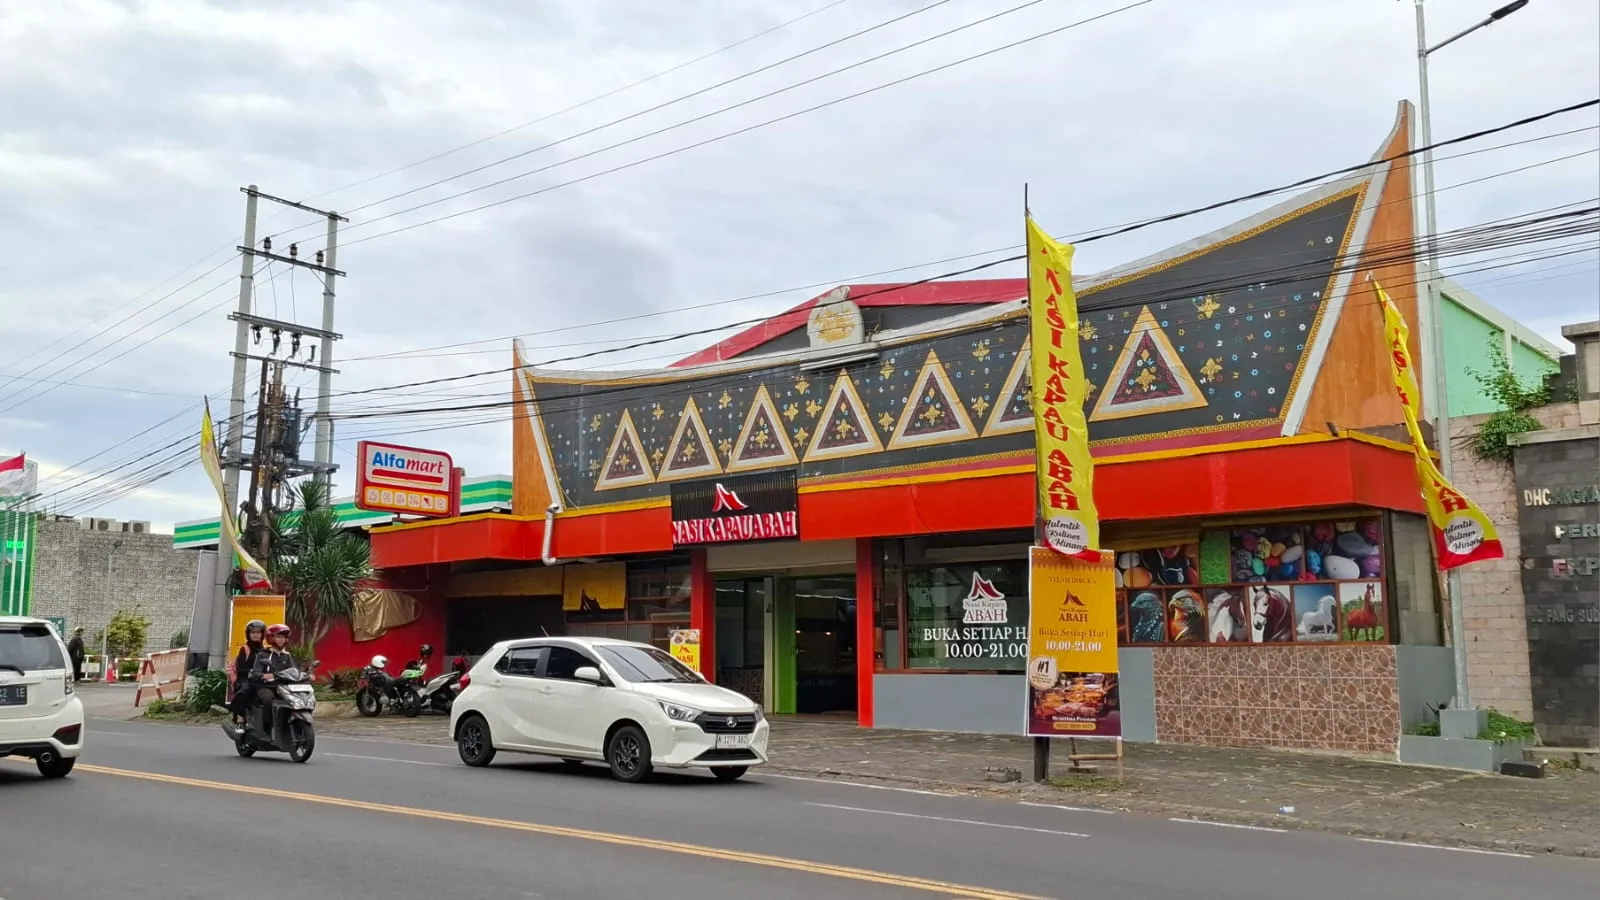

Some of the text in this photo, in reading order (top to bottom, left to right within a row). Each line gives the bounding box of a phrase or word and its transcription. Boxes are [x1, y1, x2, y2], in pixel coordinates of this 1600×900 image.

[372, 451, 444, 474] Alfamart
[1047, 448, 1080, 512] ABAH
[965, 609, 1005, 622] ABAH
[1058, 612, 1089, 623] ABAH
[924, 628, 961, 641] BUKA
[963, 627, 1012, 641] SETIAP
[1039, 627, 1109, 640] Buka Setiap Hari
[944, 643, 1028, 658] 10.00-21.00
[1045, 640, 1102, 652] 10.00-21.00
[1037, 660, 1050, 674] #1
